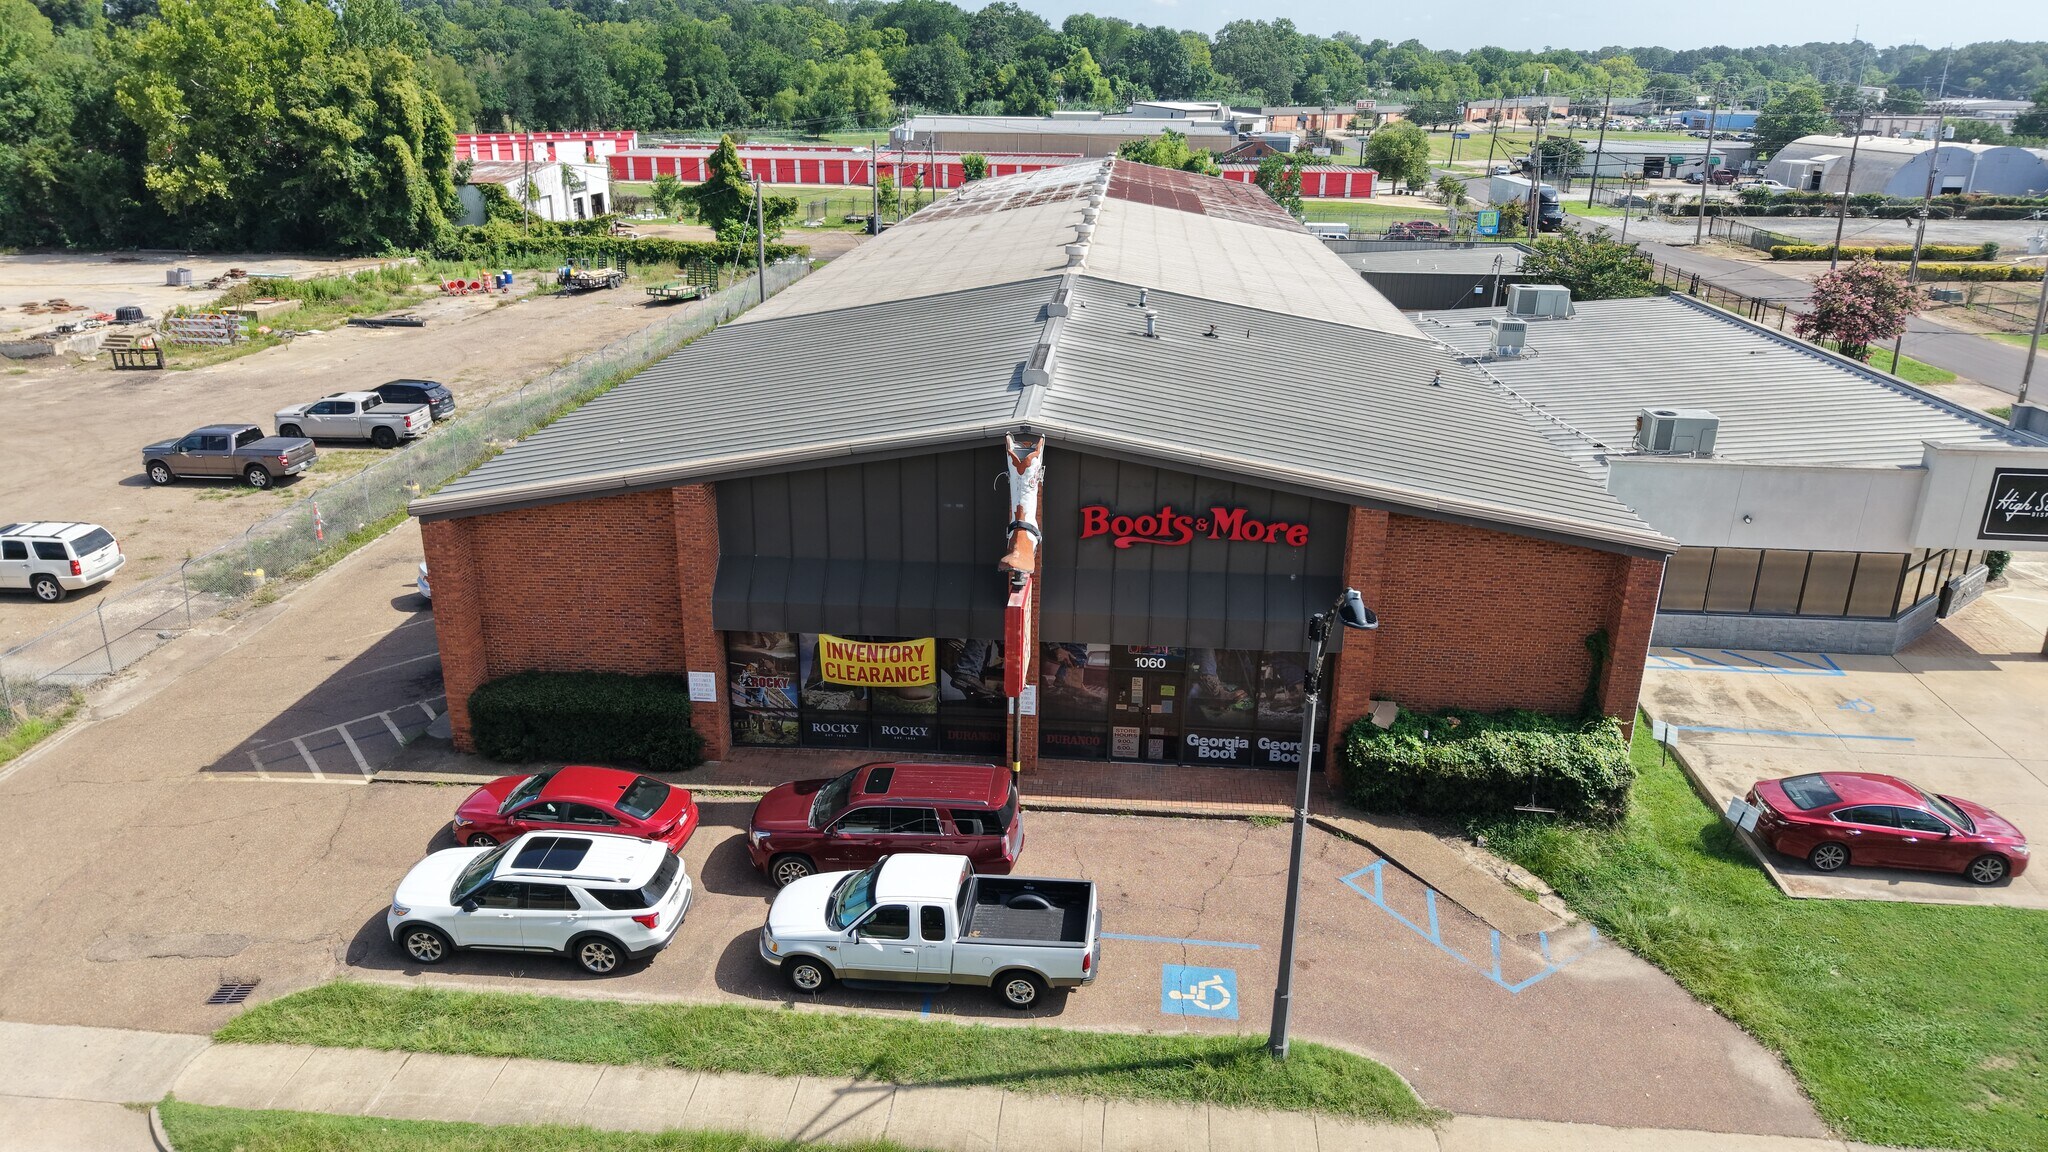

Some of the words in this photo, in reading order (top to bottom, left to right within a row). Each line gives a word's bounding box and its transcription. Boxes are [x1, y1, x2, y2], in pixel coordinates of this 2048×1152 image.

[1995, 488, 2037, 522] High
[1080, 505, 1193, 549] Boots
[1195, 518, 1208, 532] &
[1206, 507, 1309, 547] More
[826, 641, 925, 663] INVENTORY
[1134, 657, 1166, 669] 1060
[825, 662, 930, 683] CLEARANCE
[751, 676, 790, 689] ROCKY
[812, 722, 860, 734] ROCKY
[881, 725, 929, 737] ROCKY
[1046, 734, 1100, 746] DURANGO
[1186, 734, 1249, 750] Georgia
[1258, 737, 1320, 754] Georga
[1198, 746, 1237, 759] Boot
[1268, 750, 1301, 763] Boo
